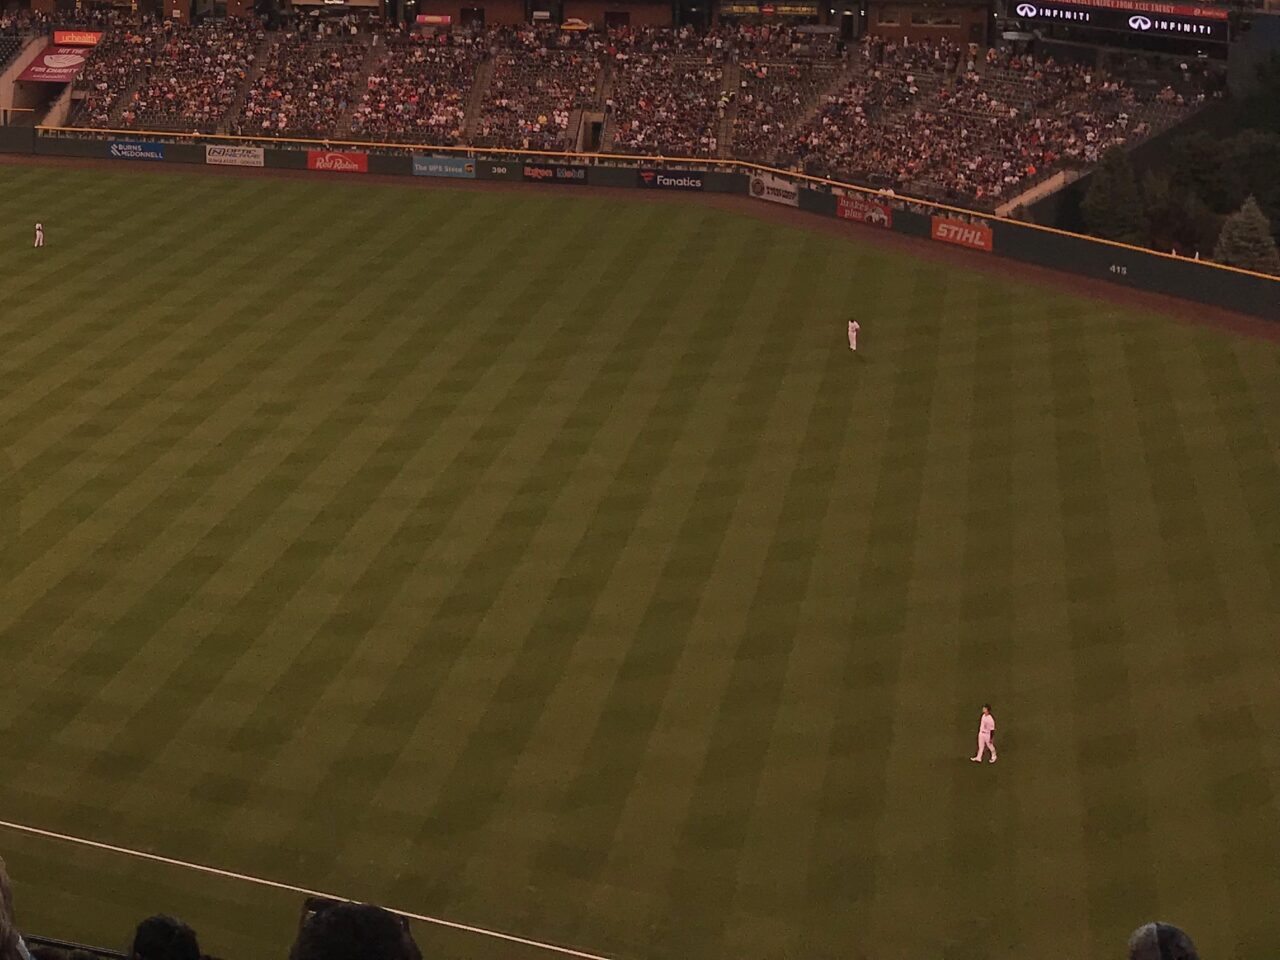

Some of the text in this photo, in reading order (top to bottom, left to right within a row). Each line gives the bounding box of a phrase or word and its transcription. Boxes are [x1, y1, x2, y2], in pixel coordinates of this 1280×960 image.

[1039, 8, 1089, 21] INFINITI
[1155, 20, 1211, 35] INFINITI
[62, 33, 97, 42] uchealth
[118, 144, 142, 152] BURNS
[316, 156, 359, 170] Red Robin
[492, 166, 506, 174] 390
[657, 175, 701, 187] Fanatics
[840, 197, 869, 211] brakes
[844, 209, 863, 219] plus
[936, 223, 985, 246] STIHL
